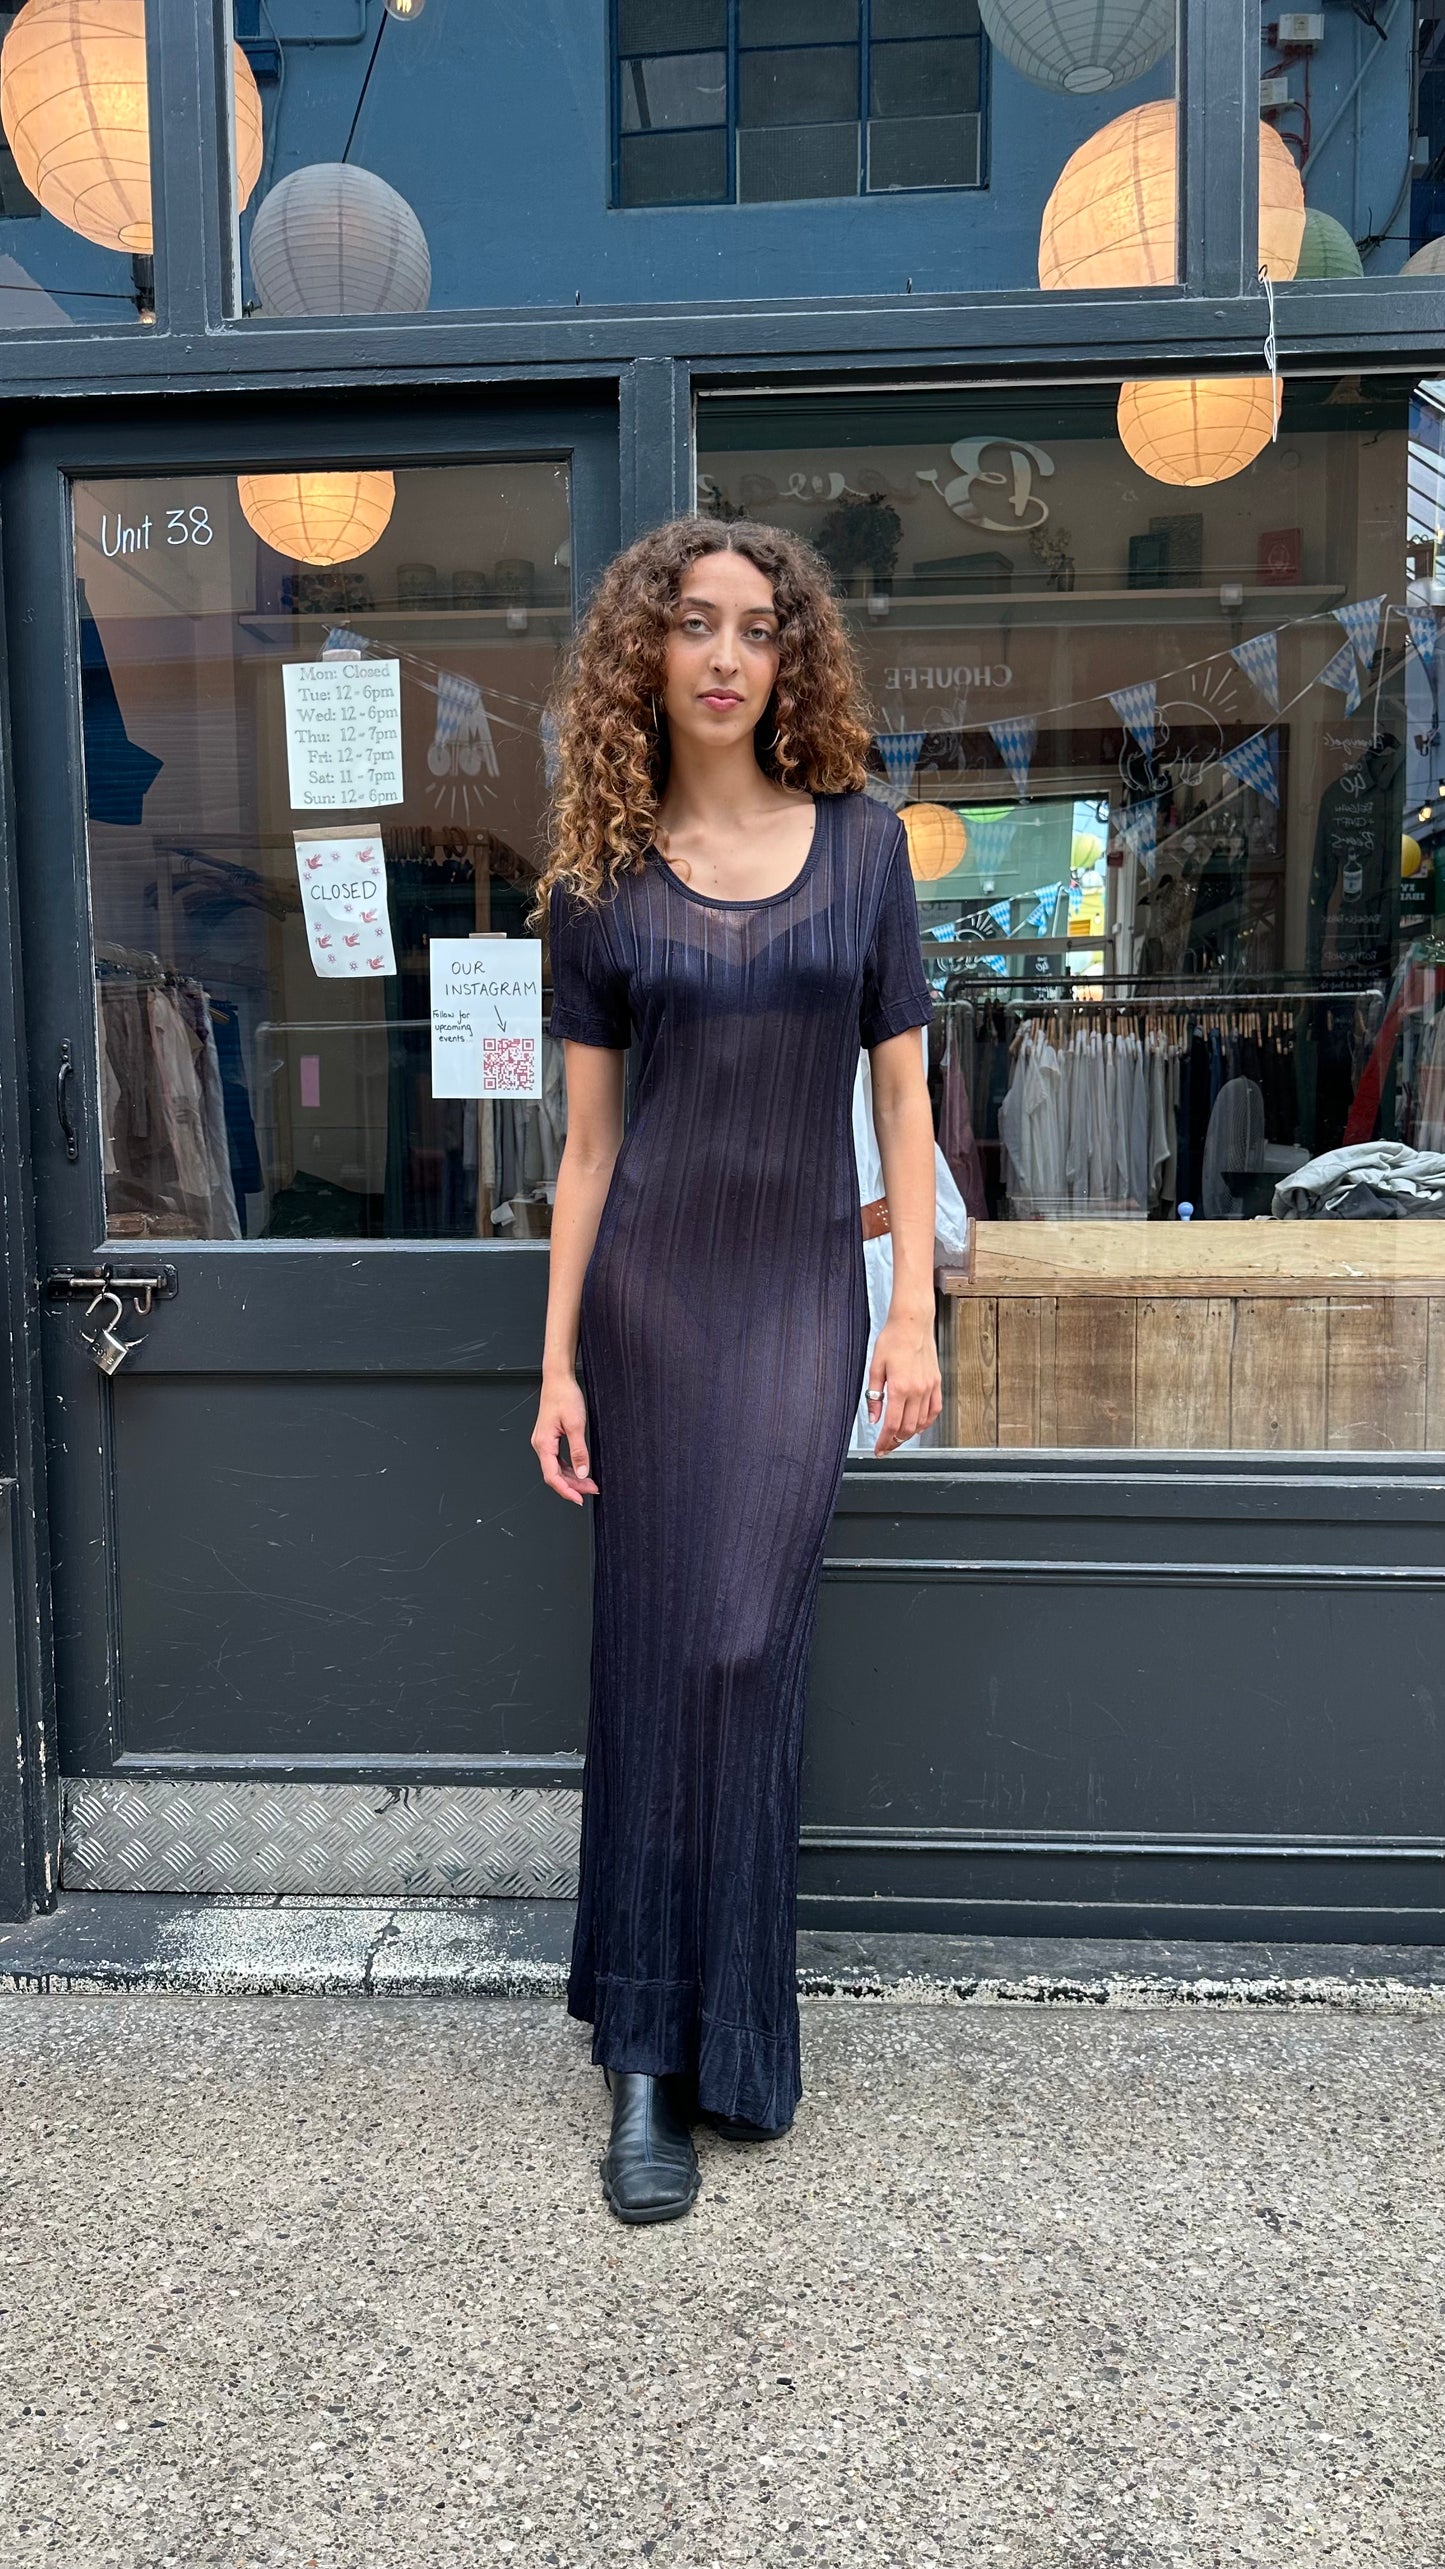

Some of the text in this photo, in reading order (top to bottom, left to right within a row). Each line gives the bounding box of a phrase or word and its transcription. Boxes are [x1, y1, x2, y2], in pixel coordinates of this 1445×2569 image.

[102, 506, 213, 557] Unit 38
[299, 664, 390, 681] Mon: Closed
[298, 688, 331, 701] Tue:
[336, 685, 352, 700] 12
[362, 685, 394, 702] 6pm
[297, 708, 336, 722] Wed:
[341, 706, 357, 721] 12
[367, 706, 398, 723] 6pm
[294, 729, 330, 743] Thu:
[340, 726, 356, 741] 12
[368, 726, 398, 744] 7pm
[308, 750, 333, 763] Fri:
[337, 747, 353, 762] 12
[365, 748, 394, 765] 7pm
[309, 770, 335, 784] Sat:
[340, 770, 353, 783] 11
[367, 769, 395, 785] 7pm
[303, 791, 336, 805] Sun:
[341, 789, 357, 804] 12
[368, 789, 399, 805] 6pm
[311, 881, 377, 900] CLOSED
[451, 961, 486, 975] OUR
[445, 981, 537, 996] INSTAGRAM
[432, 1009, 471, 1024] Follow for
[434, 1024, 473, 1037] upcoming
